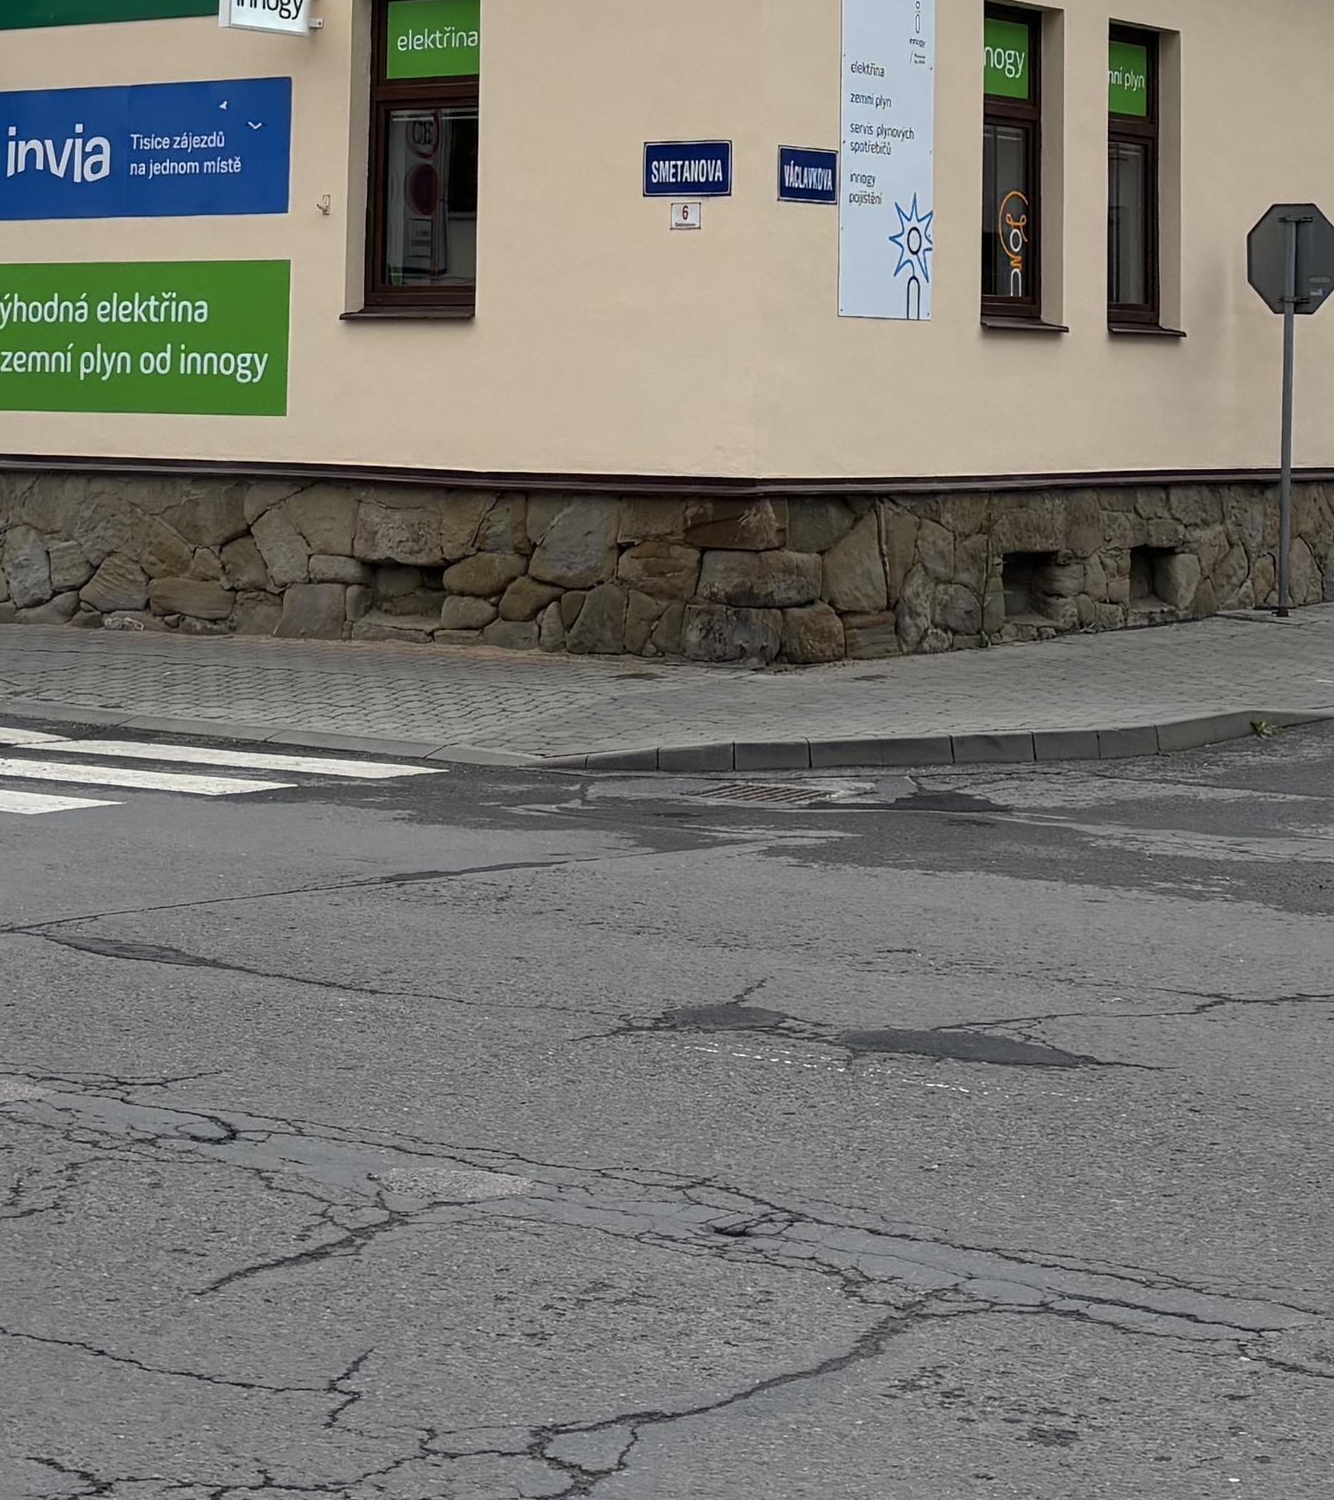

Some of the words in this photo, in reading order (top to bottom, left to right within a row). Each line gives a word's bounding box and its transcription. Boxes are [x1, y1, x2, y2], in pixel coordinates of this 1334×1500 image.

[397, 26, 479, 52] elektřina
[1124, 69, 1145, 92] plyn
[850, 123, 874, 136] servis
[6, 123, 112, 184] invia
[130, 133, 171, 151] Tisíce
[173, 130, 226, 155] zájezdů
[129, 162, 146, 176] na
[148, 158, 200, 179] jednom
[203, 155, 242, 175] místě
[650, 159, 723, 184] SMETANOVA
[784, 160, 834, 191] VÁCLAVKOVA
[681, 204, 690, 221] 6
[96, 291, 209, 323] elektřina
[0, 343, 74, 373] zemní
[79, 343, 132, 381] plyn
[139, 343, 172, 375] od
[179, 344, 269, 384] innogy
